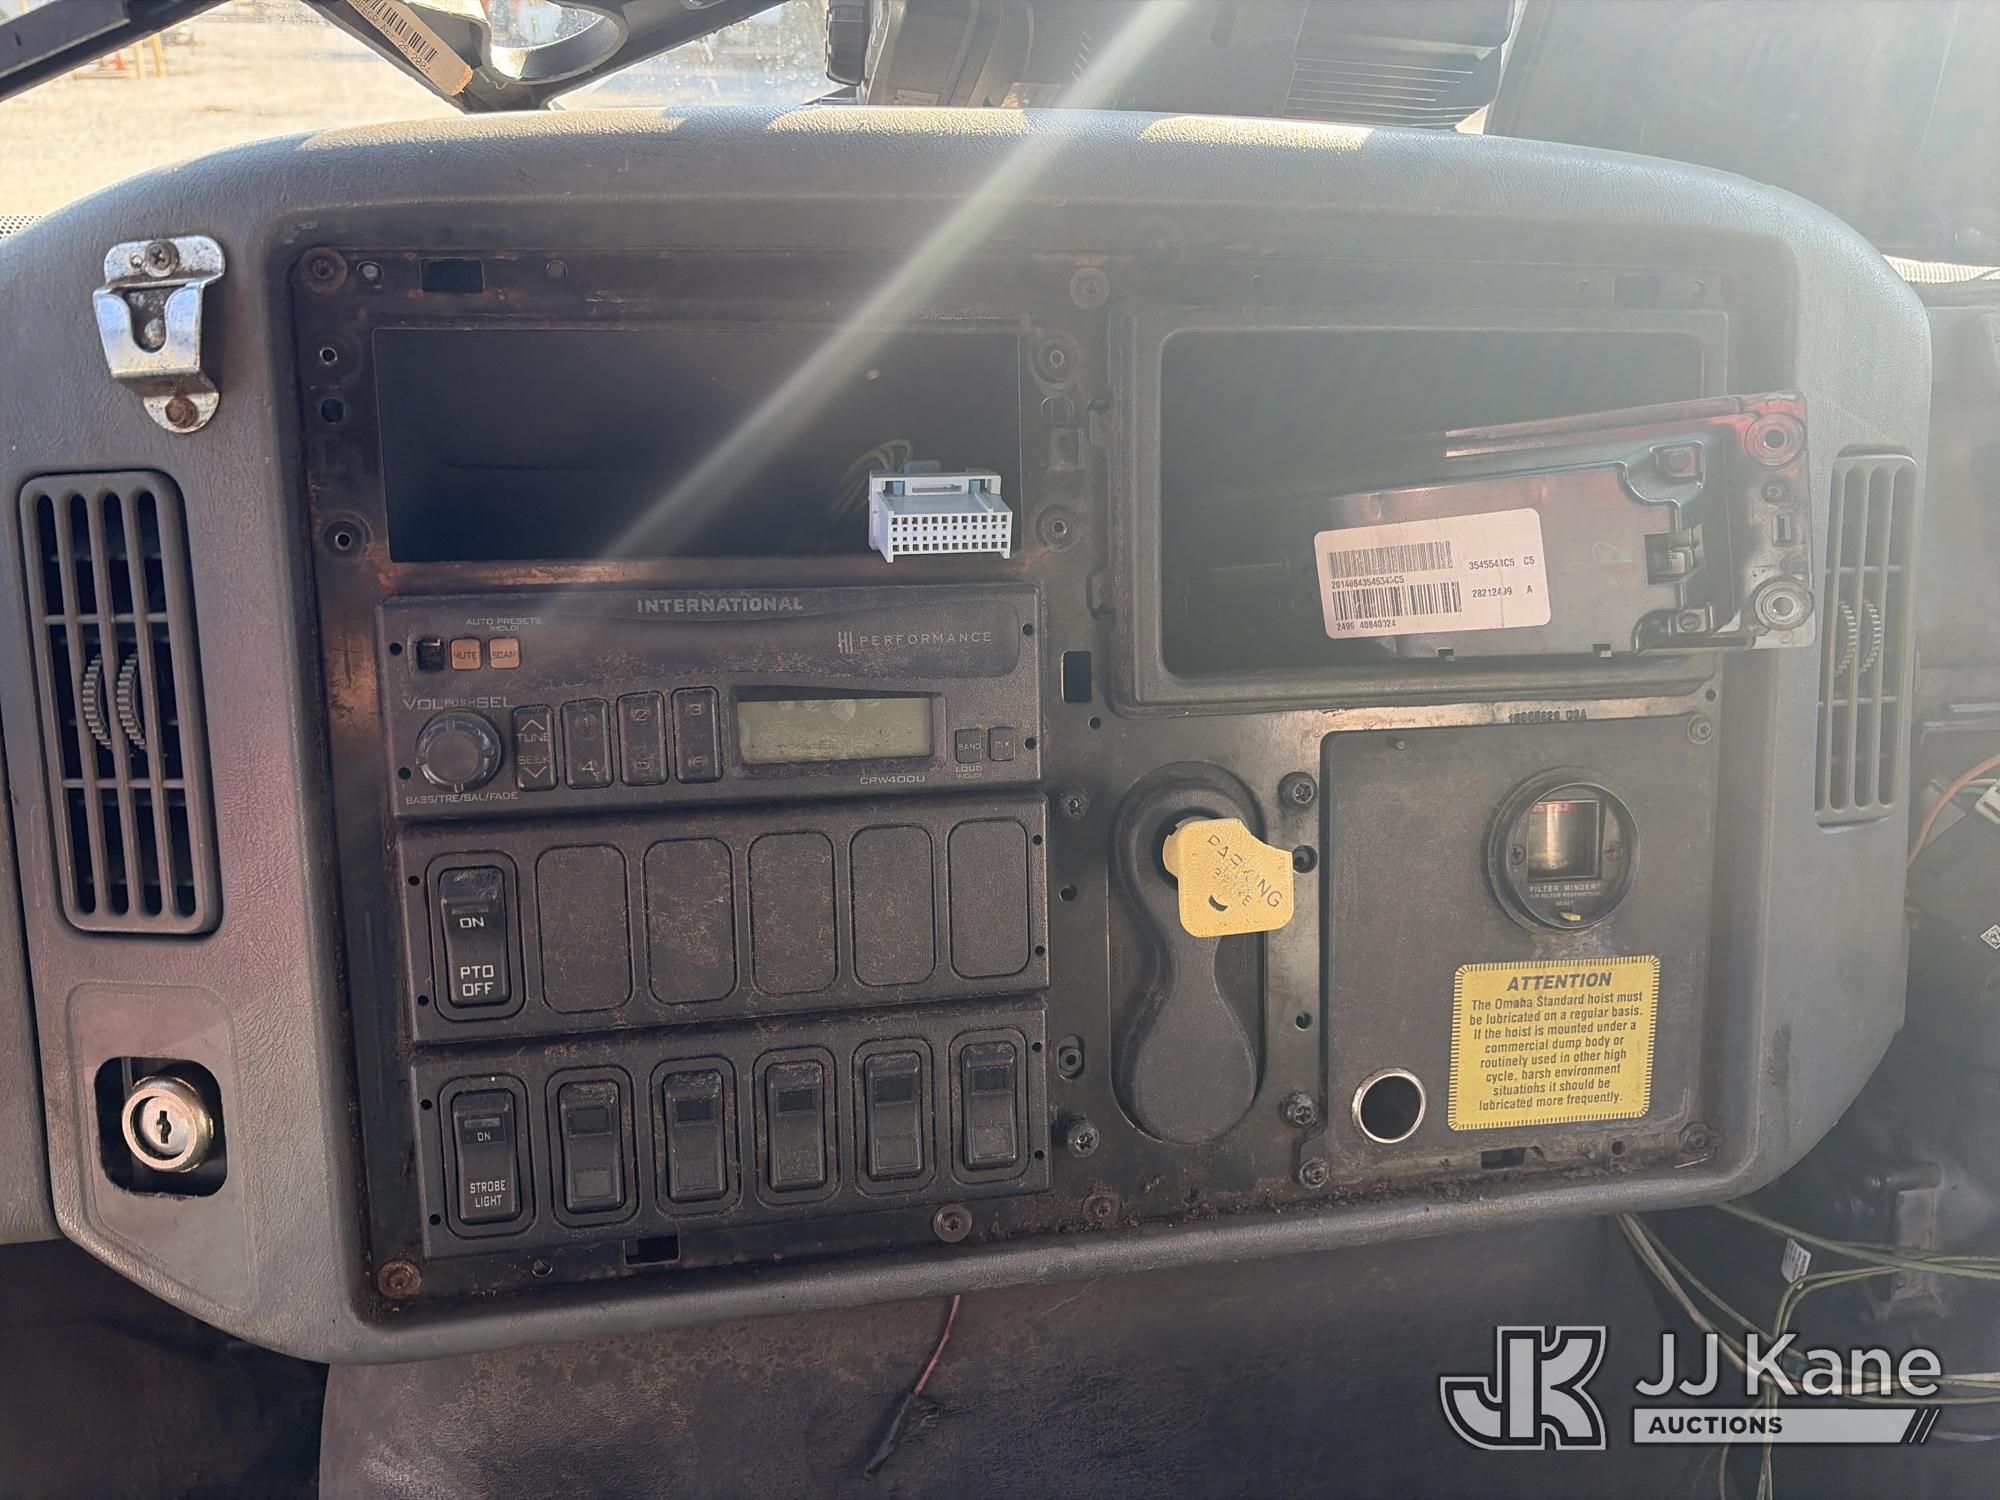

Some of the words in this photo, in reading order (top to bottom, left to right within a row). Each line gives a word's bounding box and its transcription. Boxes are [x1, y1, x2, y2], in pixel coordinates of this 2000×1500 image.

[1523, 555, 1535, 566] C5
[1526, 585, 1533, 594] A
[636, 596, 803, 614] INTERNATIONAL
[466, 618, 494, 626] AUTO
[497, 616, 543, 625] PRESETS
[859, 630, 993, 647] PERFORMANCE
[453, 650, 478, 660] MUTE
[402, 698, 444, 711] VOL
[476, 696, 514, 709] SEL
[460, 917, 485, 928] ON
[460, 965, 494, 980] PTO
[462, 982, 494, 997] OFF
[1507, 972, 1612, 992] ATTENTION
[1471, 999, 1492, 1011] The
[1495, 997, 1533, 1009] Omaha
[1536, 993, 1584, 1008] Standard
[1587, 992, 1614, 1005] hoist
[1616, 991, 1643, 1002] must
[1469, 1013, 1483, 1026] be
[1486, 1010, 1540, 1024] lubricated
[1543, 1010, 1557, 1021] on
[1560, 1010, 1567, 1020] a
[1570, 1006, 1609, 1020] regular
[1612, 1004, 1643, 1017] basis.
[1474, 1028, 1482, 1040] If
[1484, 1027, 1501, 1039] the
[1504, 1026, 1532, 1038] hoist
[1534, 1025, 1544, 1036] is
[1547, 1022, 1594, 1035] mounted
[1597, 1020, 1628, 1032] under
[1630, 1021, 1637, 1031] a
[1485, 1040, 1549, 1054] commercial
[1552, 1040, 1582, 1052] dump
[1585, 1036, 1610, 1050] body
[1613, 1036, 1625, 1046] or
[1480, 1054, 1528, 1070] routinely
[1531, 1052, 1557, 1065] used
[1560, 1051, 1571, 1063] in
[1573, 1049, 1601, 1062] other
[1604, 1047, 1627, 1061] high
[1486, 1069, 1519, 1084] cycle,
[1521, 1066, 1551, 1080] harsh
[1555, 1063, 1621, 1077] environment
[1493, 1082, 1546, 1096] situations
[1549, 1081, 1557, 1092] it
[1559, 1078, 1594, 1091] should
[1597, 1076, 1611, 1089] be
[1479, 1097, 1533, 1111] lubricated
[1536, 1097, 1564, 1108] more
[1566, 1090, 1623, 1105] frequently.
[477, 1132, 491, 1142] ON
[470, 1180, 506, 1194] STROBE
[475, 1195, 502, 1208] LIGHT
